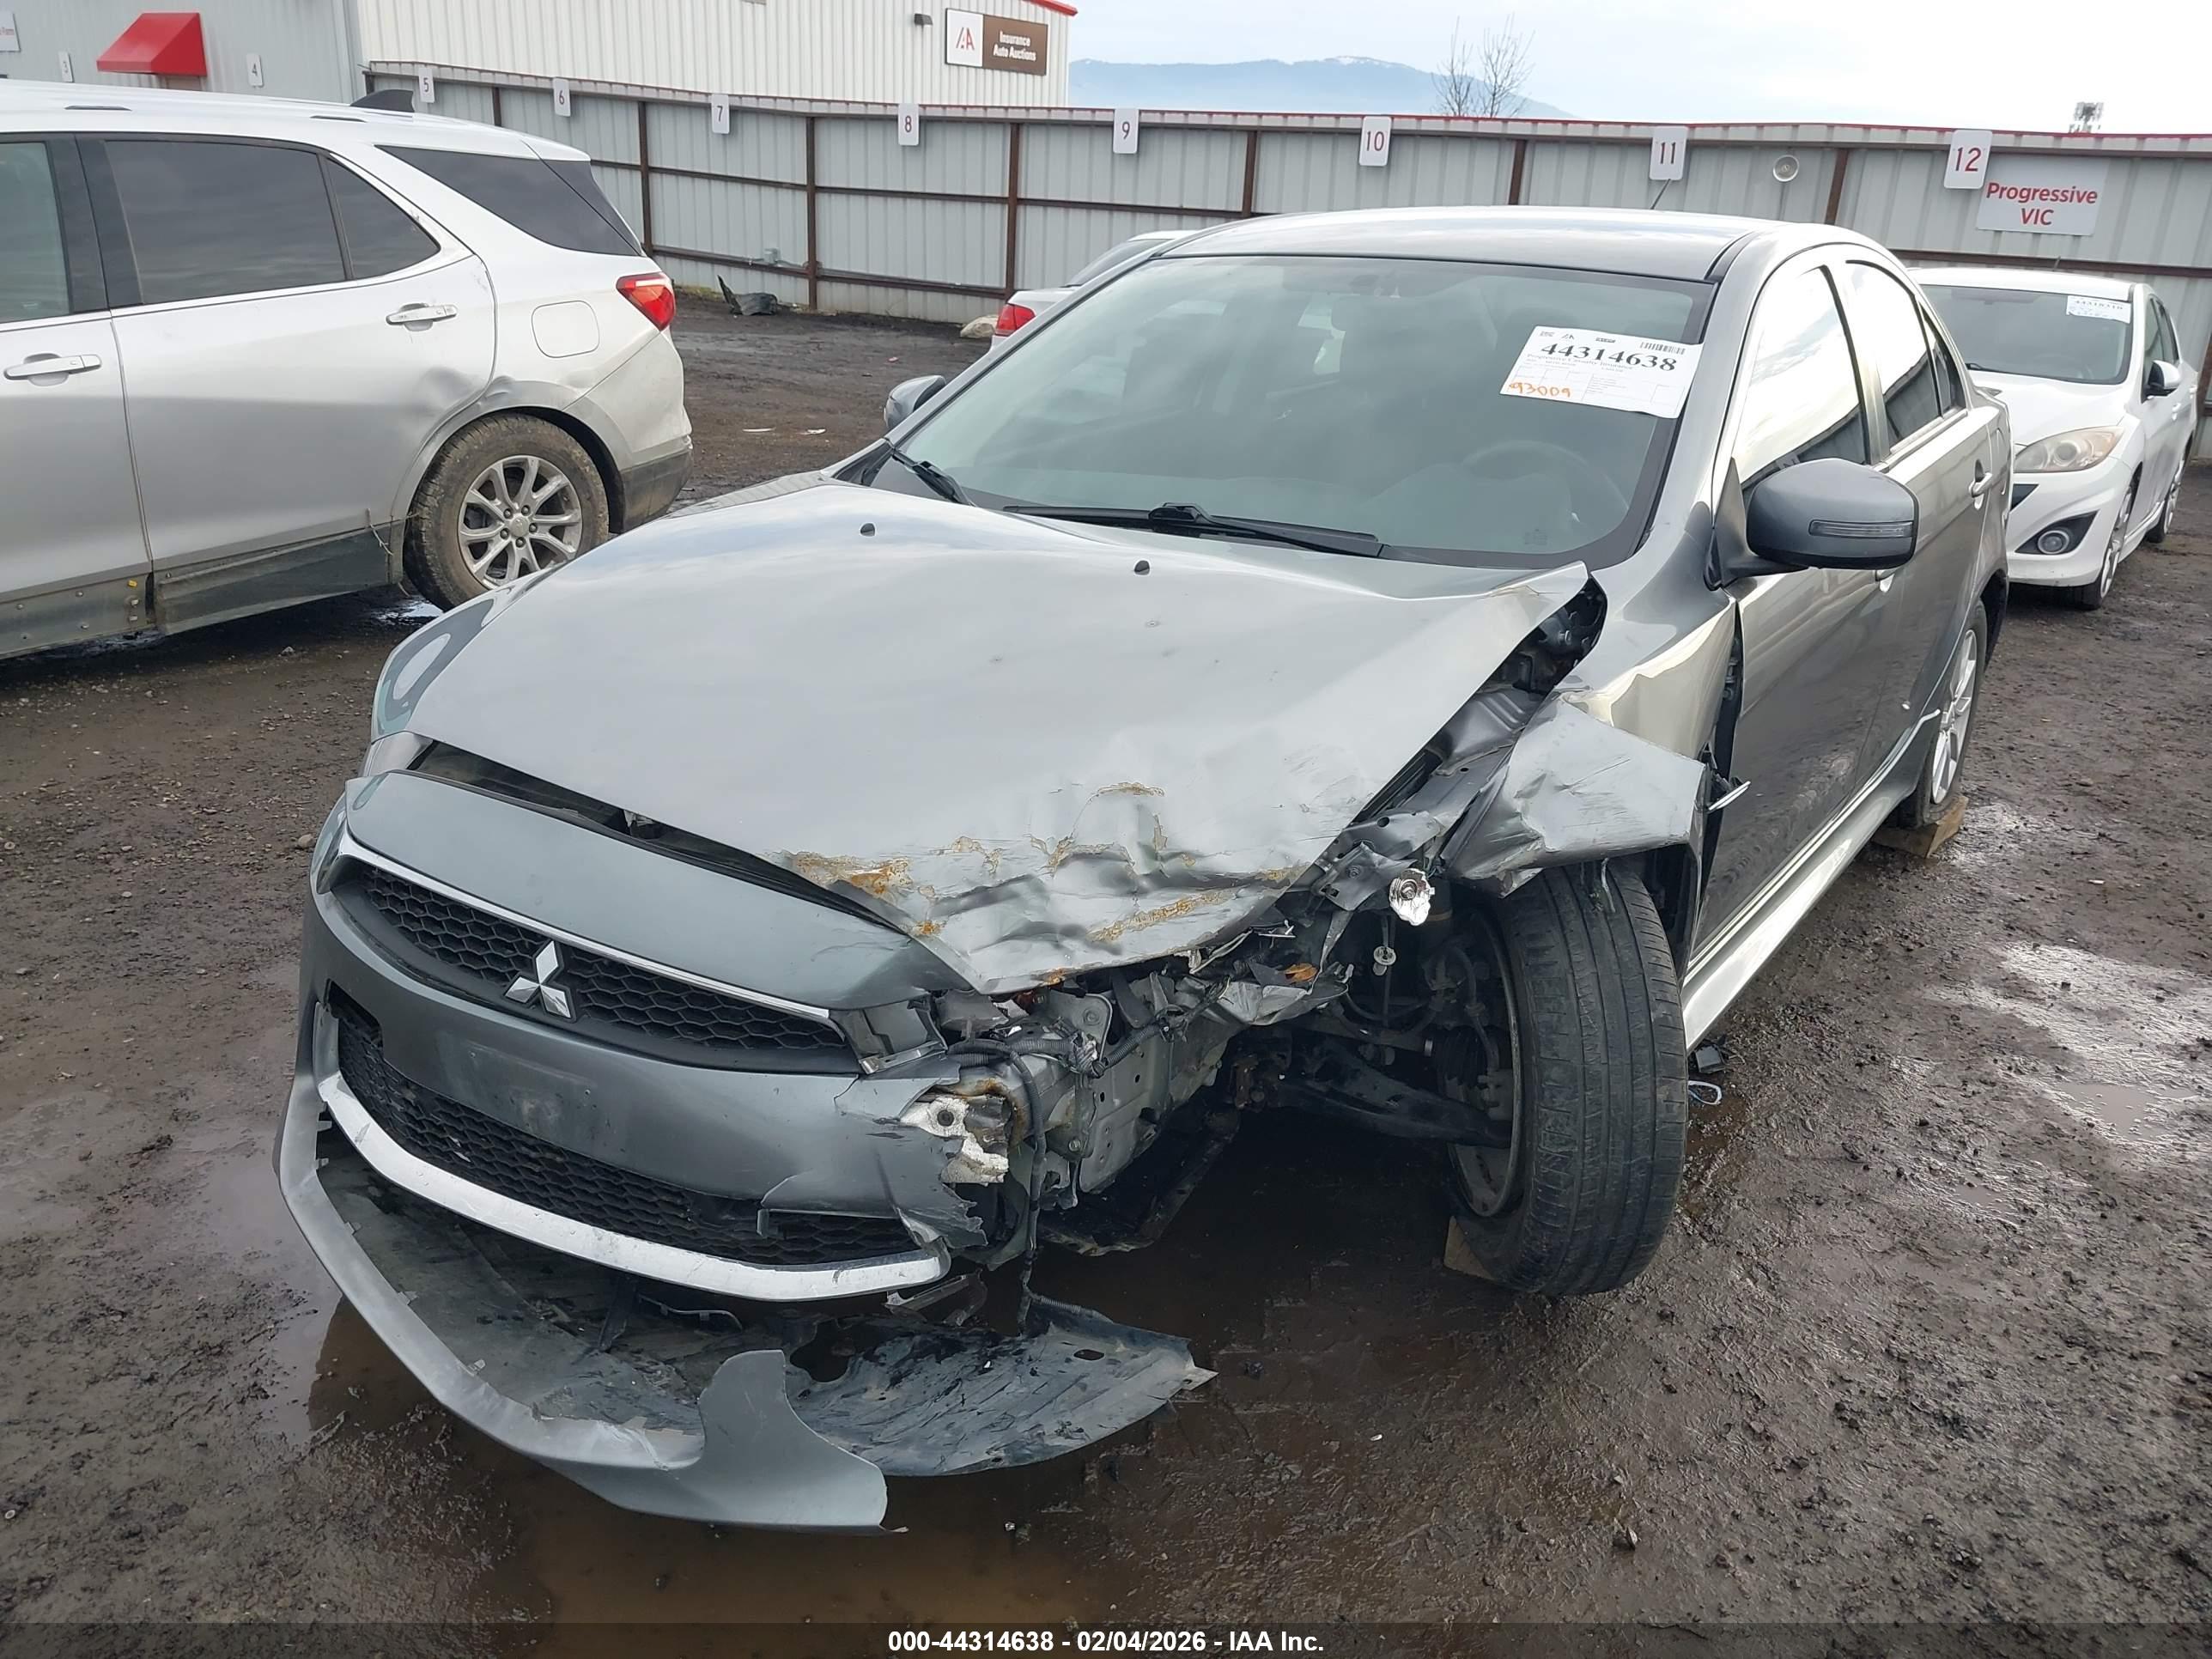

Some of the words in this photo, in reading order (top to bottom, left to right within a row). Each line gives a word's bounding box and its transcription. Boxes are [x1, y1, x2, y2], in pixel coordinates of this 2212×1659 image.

[1000, 30, 1030, 47] Insurance
[993, 43, 1009, 58] Auto
[1009, 46, 1036, 61] Auctions
[252, 63, 258, 76] 4
[422, 76, 429, 93] 5
[559, 89, 567, 105] 6
[716, 105, 723, 122] 7
[904, 115, 912, 133] 8
[1121, 121, 1130, 140] 9
[1366, 131, 1384, 151] 10
[1660, 142, 1676, 164] 11
[1955, 147, 1981, 172] 12
[1986, 182, 2098, 204] Progressive
[2021, 208, 2054, 226] VIC
[1540, 343, 1677, 372] 44314638
